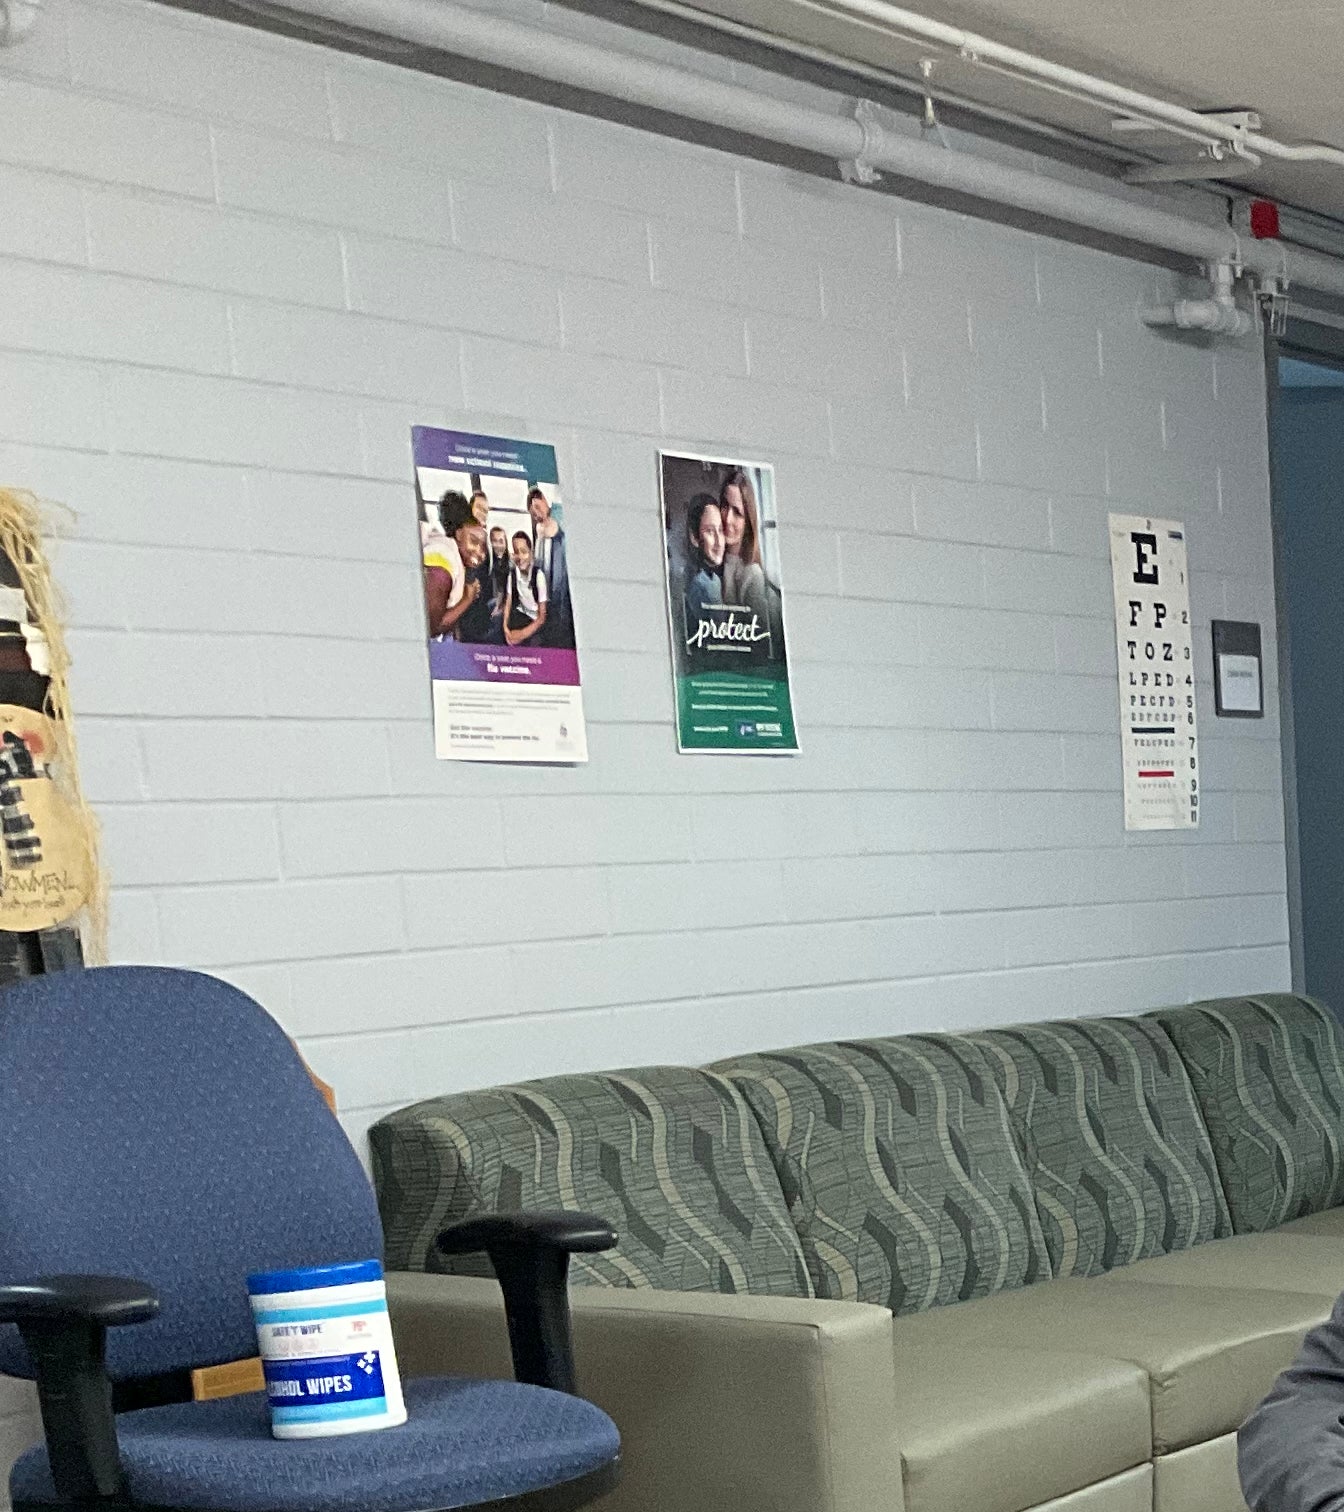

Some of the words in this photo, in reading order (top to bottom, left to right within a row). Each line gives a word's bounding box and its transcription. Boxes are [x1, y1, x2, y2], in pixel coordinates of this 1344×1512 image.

[1130, 531, 1159, 585] E
[1181, 609, 1189, 625] 2
[686, 612, 771, 648] protect
[1183, 646, 1191, 661] 3
[1185, 674, 1193, 688] 4
[1186, 695, 1193, 708] 5
[1187, 711, 1194, 725] 6
[1188, 736, 1195, 749] 7
[1189, 757, 1196, 769] 8
[1190, 779, 1197, 792] 9
[1190, 795, 1198, 807] 10
[305, 1374, 353, 1396] WIPES
